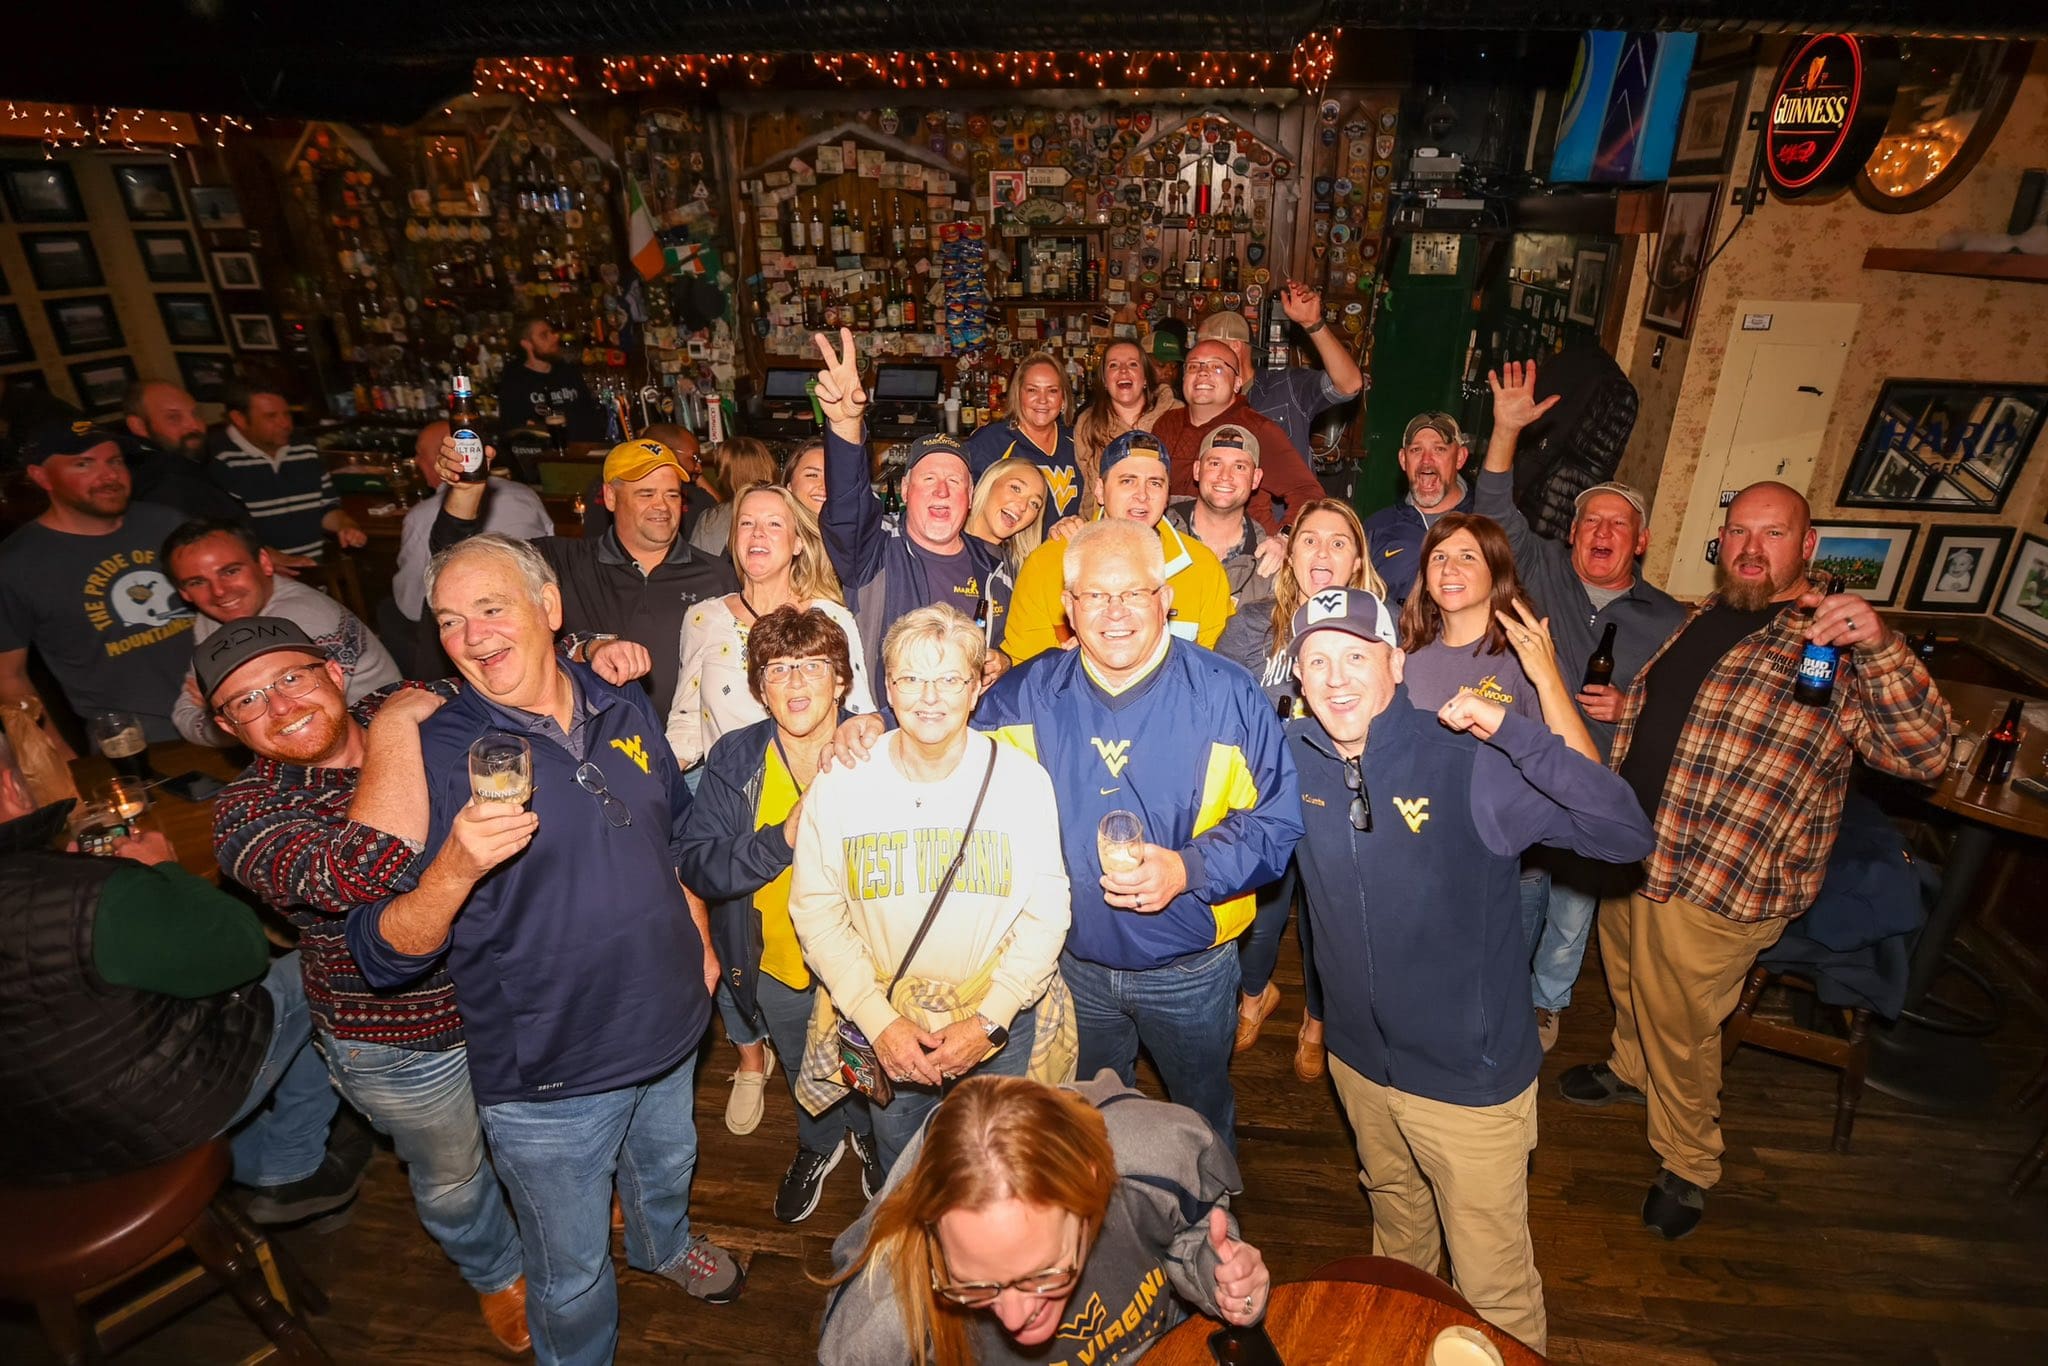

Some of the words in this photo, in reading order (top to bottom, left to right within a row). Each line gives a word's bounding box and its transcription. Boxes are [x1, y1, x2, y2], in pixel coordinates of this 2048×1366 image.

[1773, 94, 1847, 125] GUINNESS
[1880, 417, 2016, 458] HARP
[131, 549, 155, 565] OF
[83, 552, 130, 597] PRIDE
[83, 601, 114, 632] THE
[1799, 663, 1832, 679] LIGHT
[1804, 657, 1829, 669] BUD
[478, 787, 521, 799] GUINNESS
[842, 830, 908, 901] WEST
[913, 827, 1013, 897] VIRGINIA
[1077, 1267, 1166, 1366] VIRGINI
